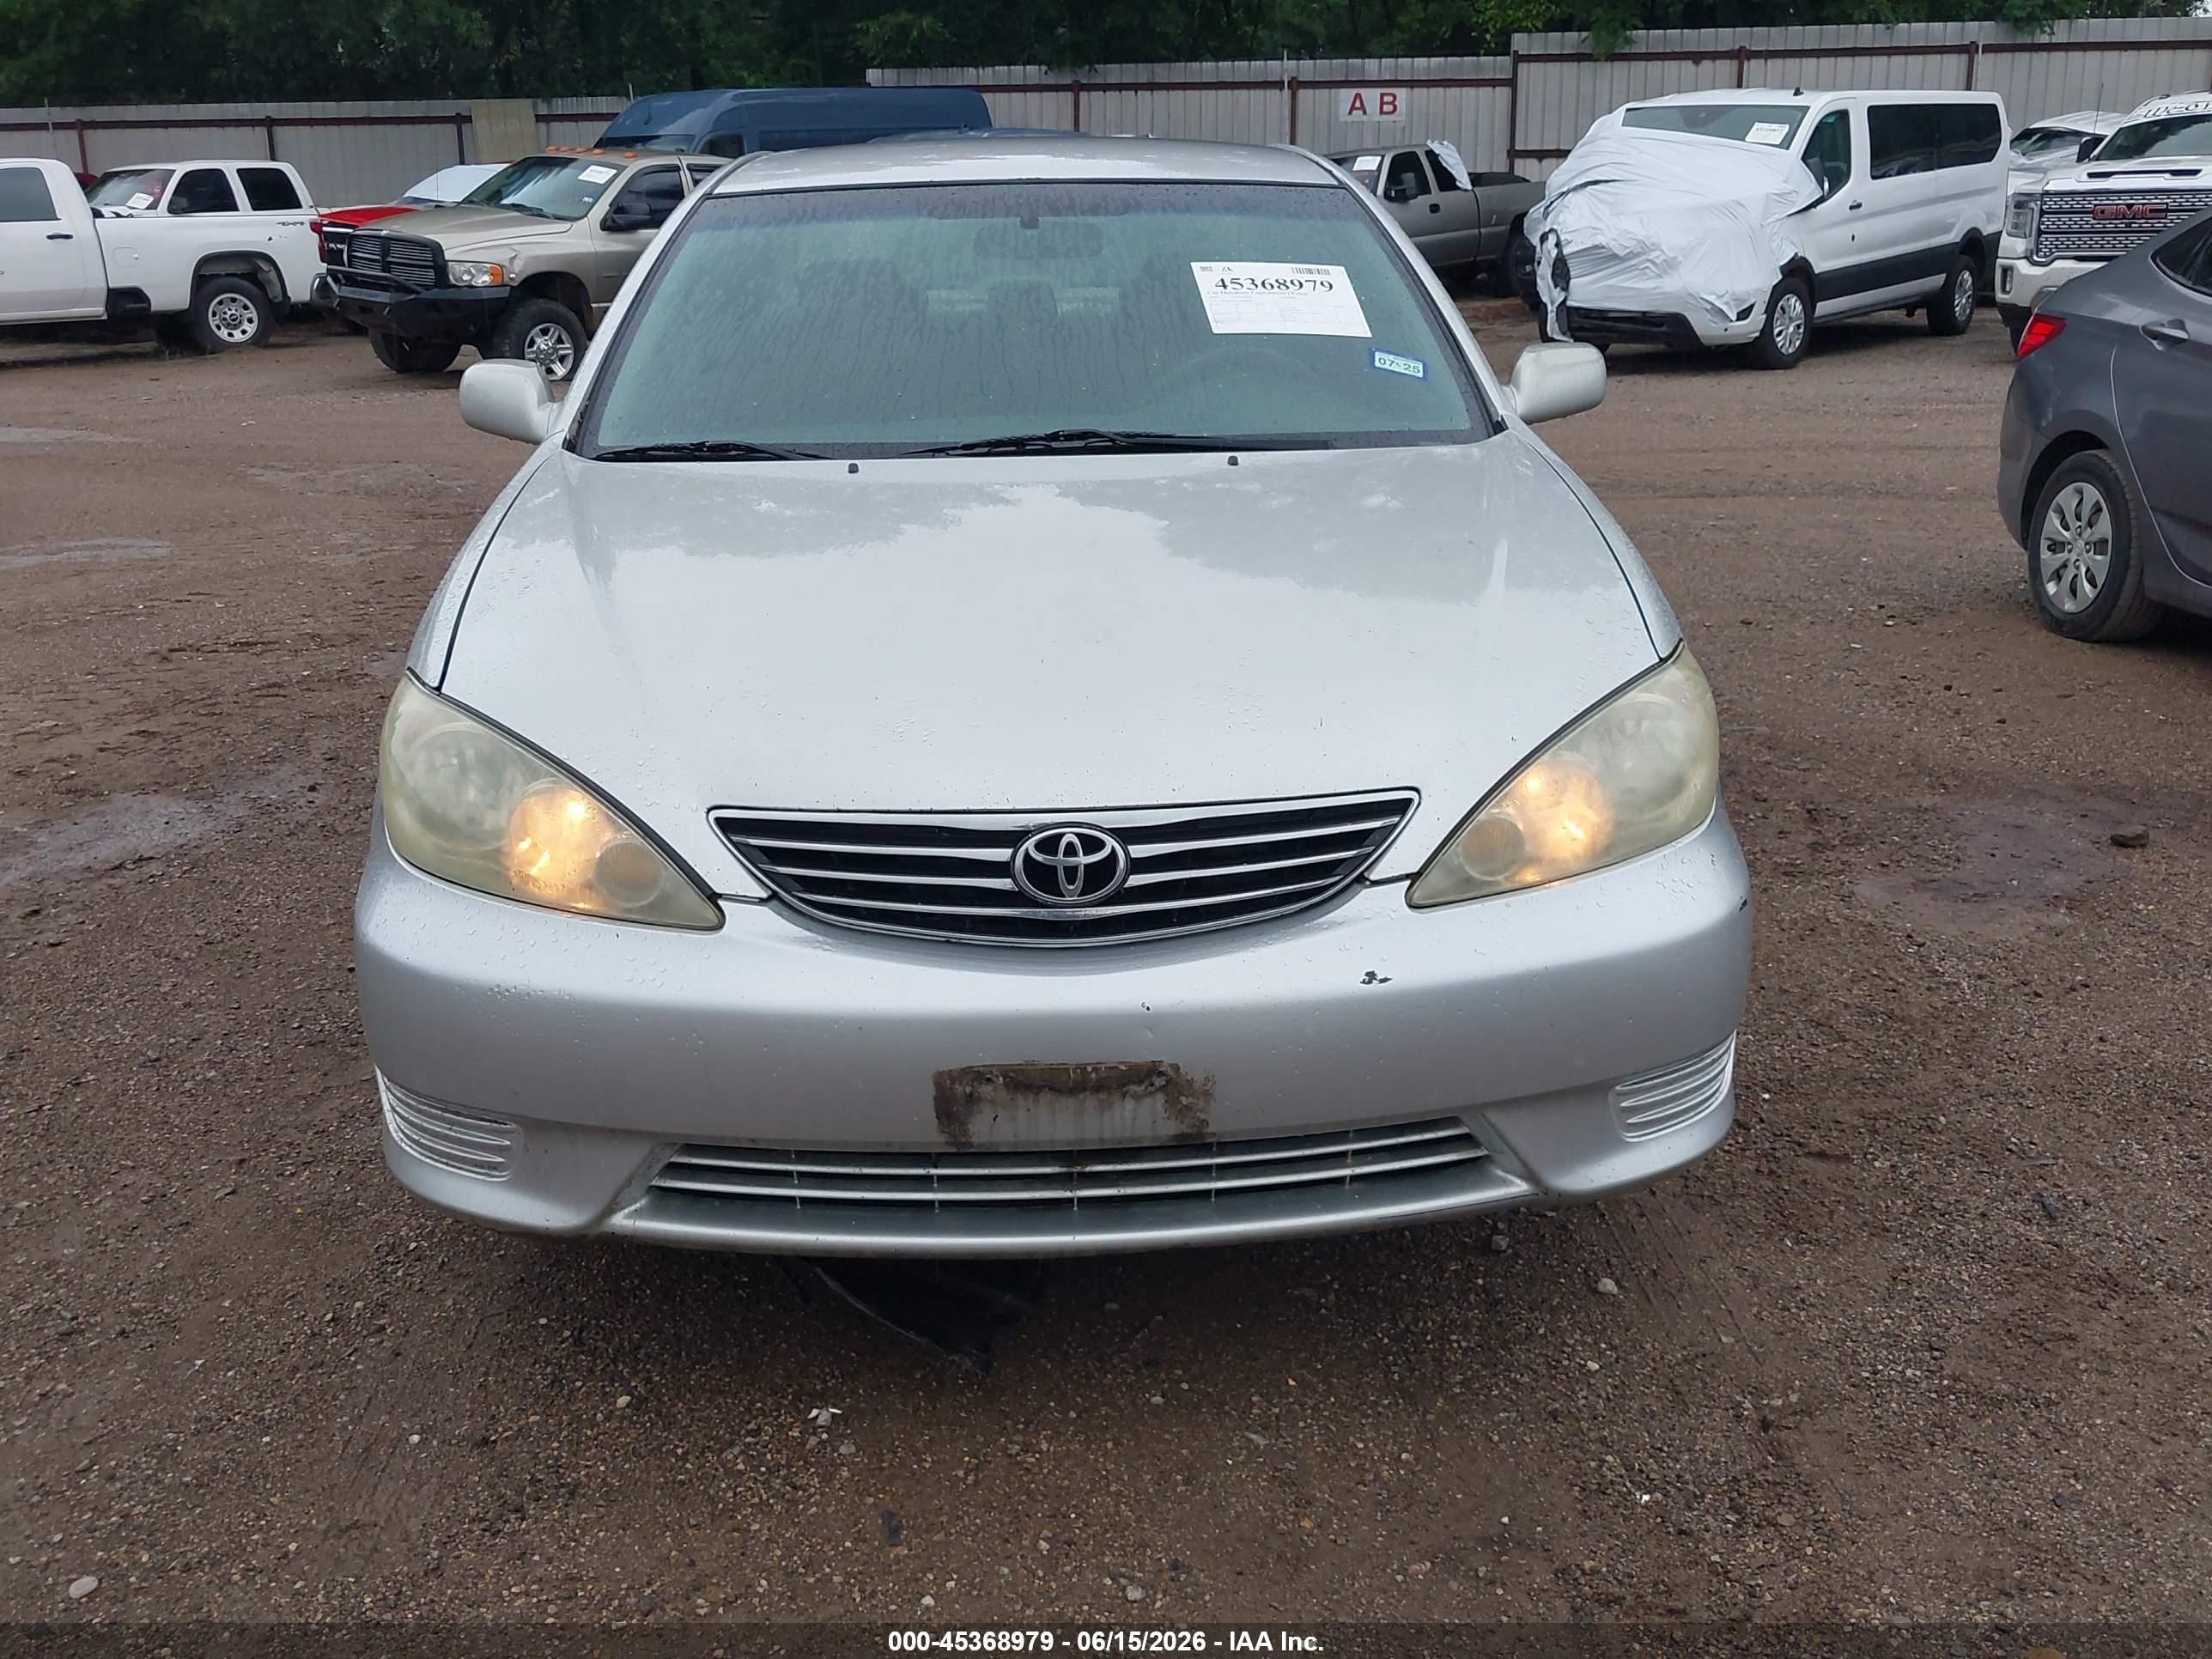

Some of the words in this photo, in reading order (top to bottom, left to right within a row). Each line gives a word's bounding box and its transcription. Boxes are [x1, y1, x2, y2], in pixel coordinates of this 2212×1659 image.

[1347, 92, 1368, 116] A
[1379, 92, 1398, 116] B
[2094, 204, 2167, 219] GMC
[1214, 276, 1334, 293] 45368979
[1377, 356, 1395, 368] 07
[1402, 362, 1421, 374] 25
